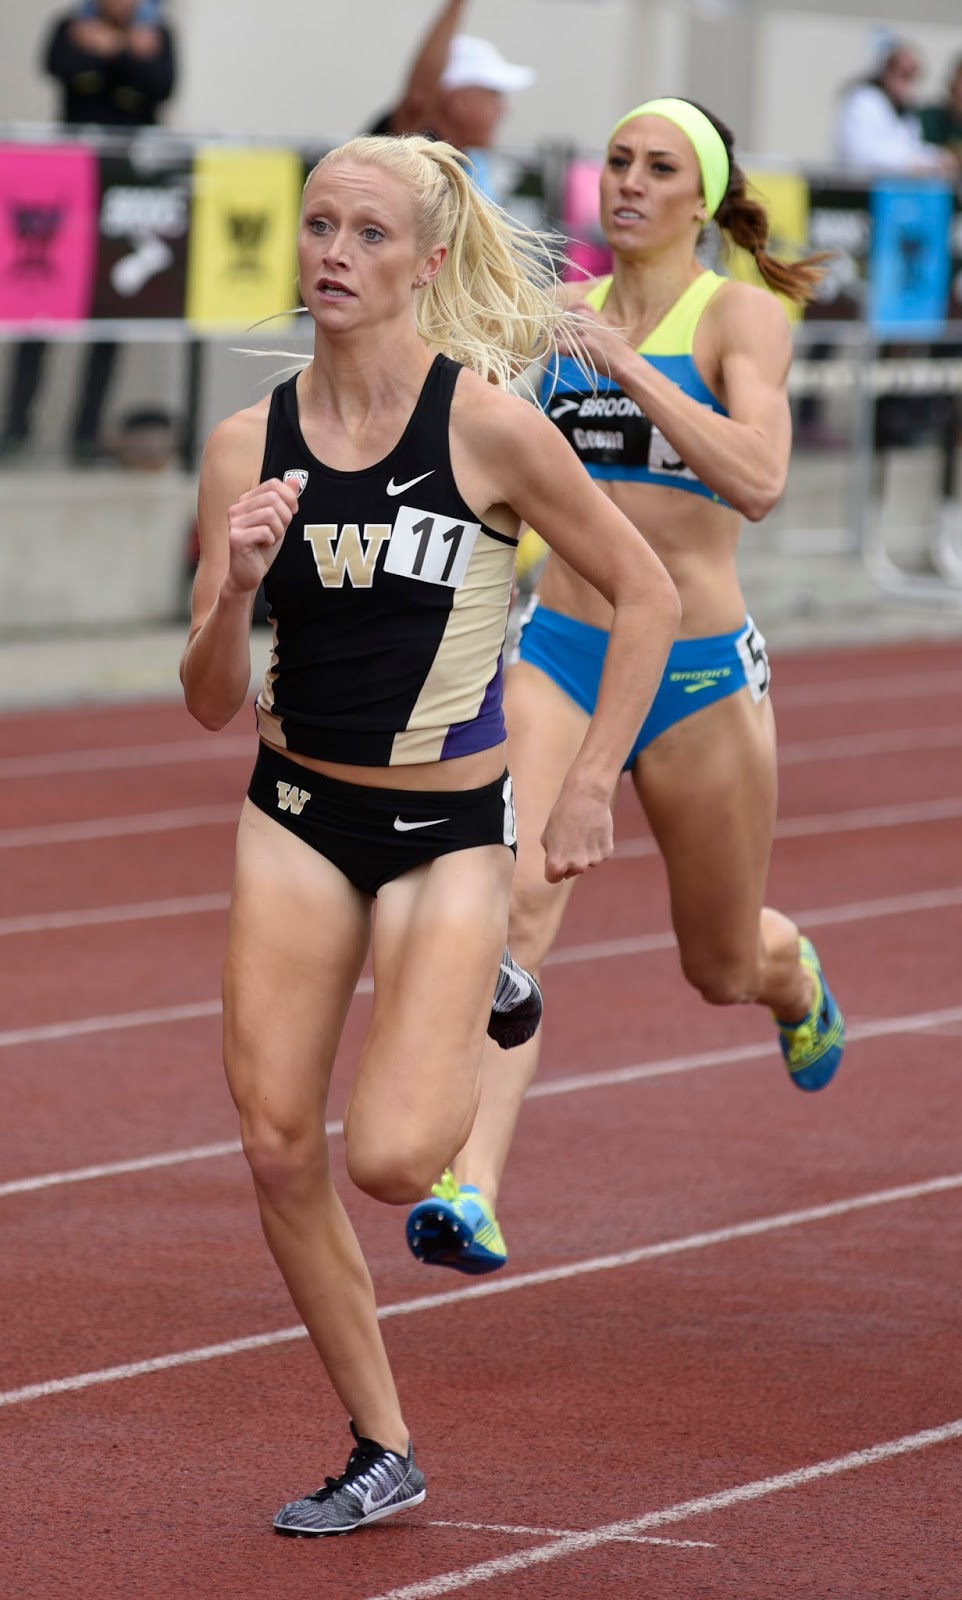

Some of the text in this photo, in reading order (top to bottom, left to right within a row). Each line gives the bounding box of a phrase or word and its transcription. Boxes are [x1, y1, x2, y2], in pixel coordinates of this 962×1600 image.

[577, 397, 645, 418] BROOK
[304, 524, 392, 588] W
[411, 516, 466, 583] 11
[746, 630, 768, 694] 5
[276, 780, 312, 816] W
